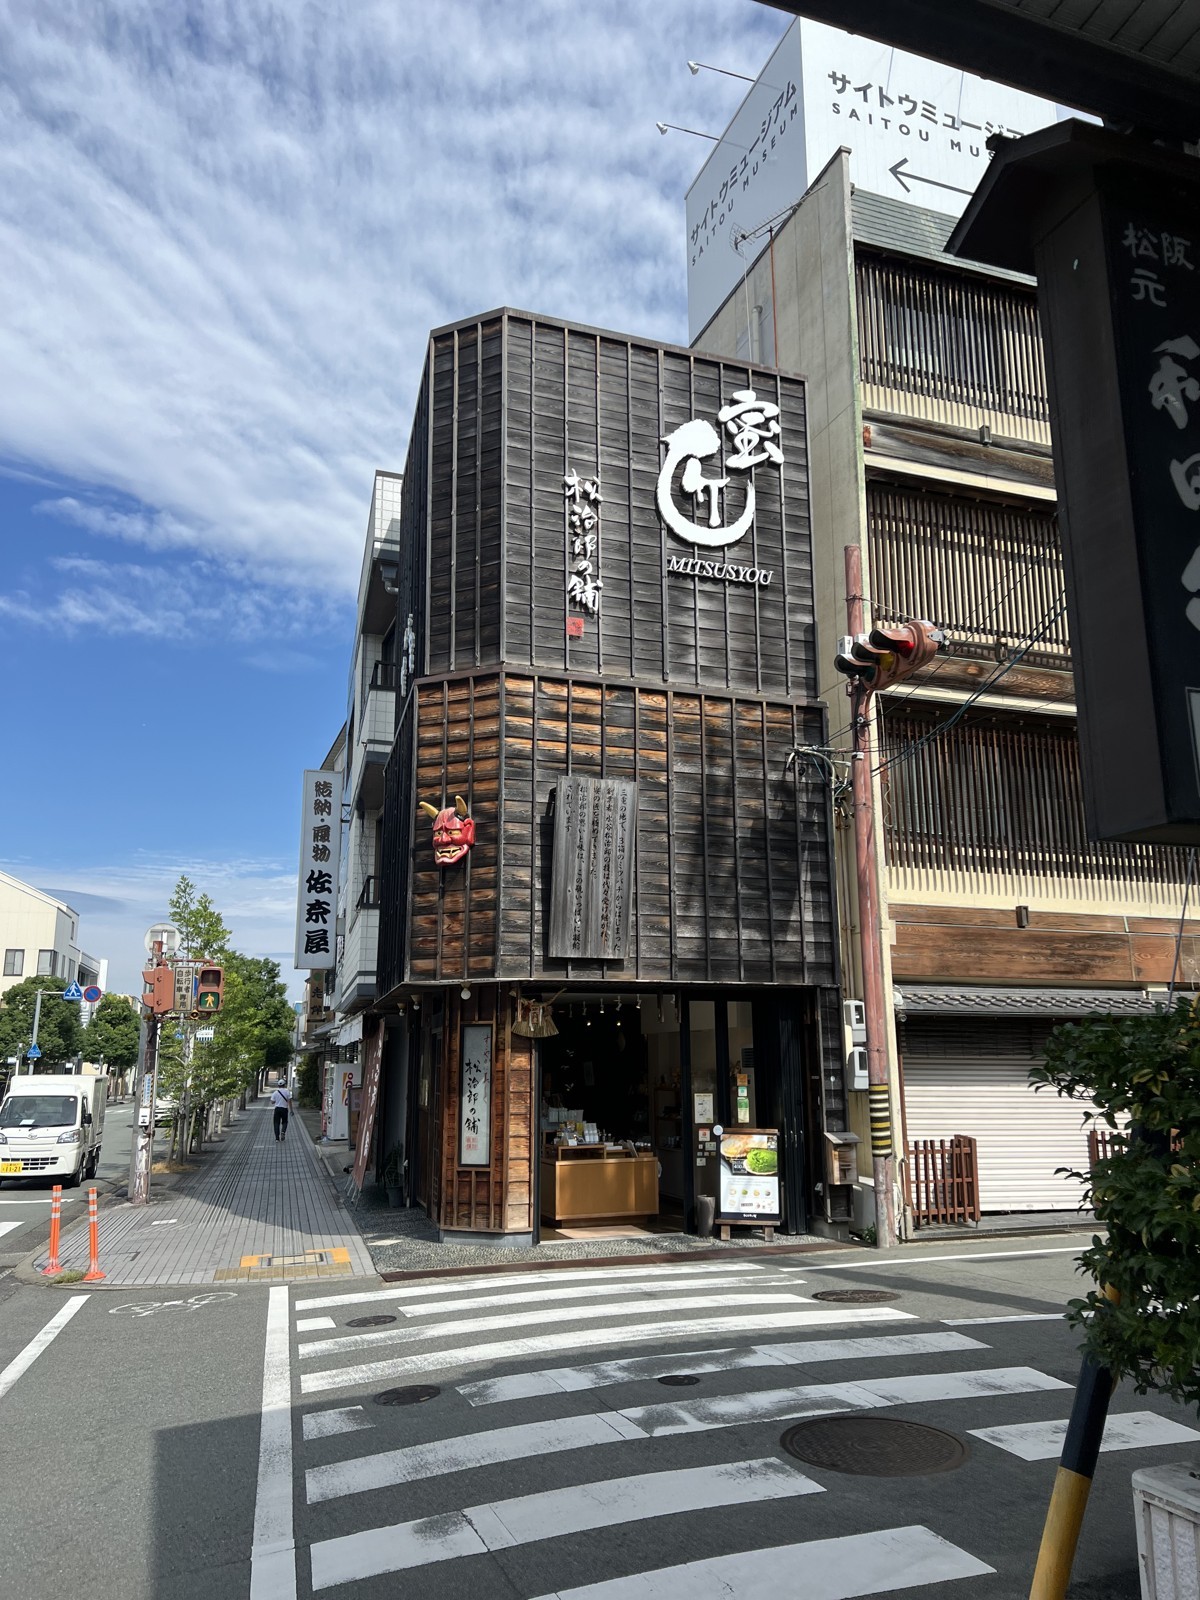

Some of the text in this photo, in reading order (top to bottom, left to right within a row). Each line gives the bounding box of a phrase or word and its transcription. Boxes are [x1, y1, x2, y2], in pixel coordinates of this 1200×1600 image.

[832, 102, 929, 142] SAITOU
[690, 80, 797, 246] サイトウミュージアム
[692, 103, 798, 267] SAITOU MUSEUM
[1122, 222, 1195, 270] 松阪
[667, 555, 774, 586] MITSUSYOU
[304, 869, 333, 954] 佐奈屋
[176, 969, 184, 993] 自転車
[184, 969, 192, 993] 歩行者
[465, 1058, 481, 1134] 松治郎の舗
